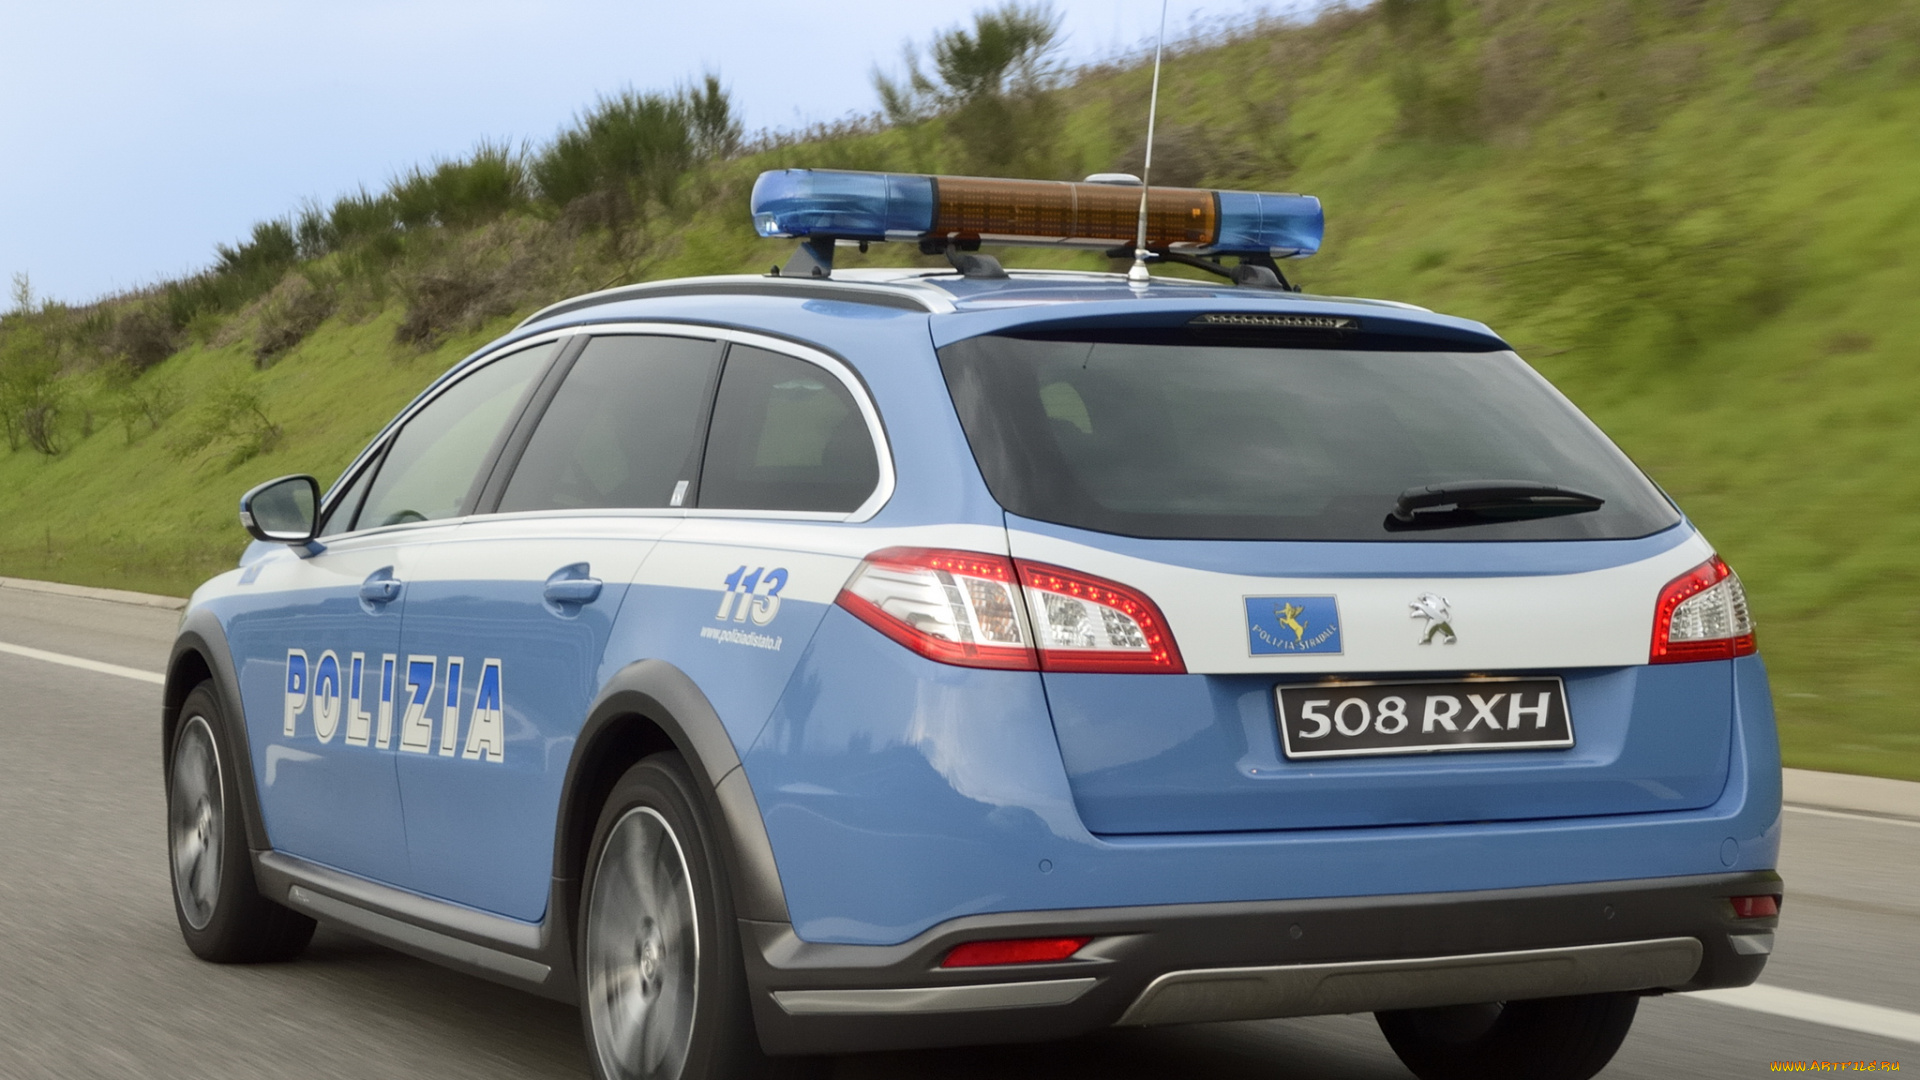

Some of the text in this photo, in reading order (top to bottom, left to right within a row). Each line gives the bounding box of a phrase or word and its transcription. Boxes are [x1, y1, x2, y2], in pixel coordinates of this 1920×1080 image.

[715, 565, 789, 626] 113
[700, 626, 782, 651] www.poliziadistato.it
[1252, 624, 1337, 650] POLIZIA STRADALE
[283, 648, 504, 763] POLIZIA
[1299, 692, 1551, 738] 508 RXH
